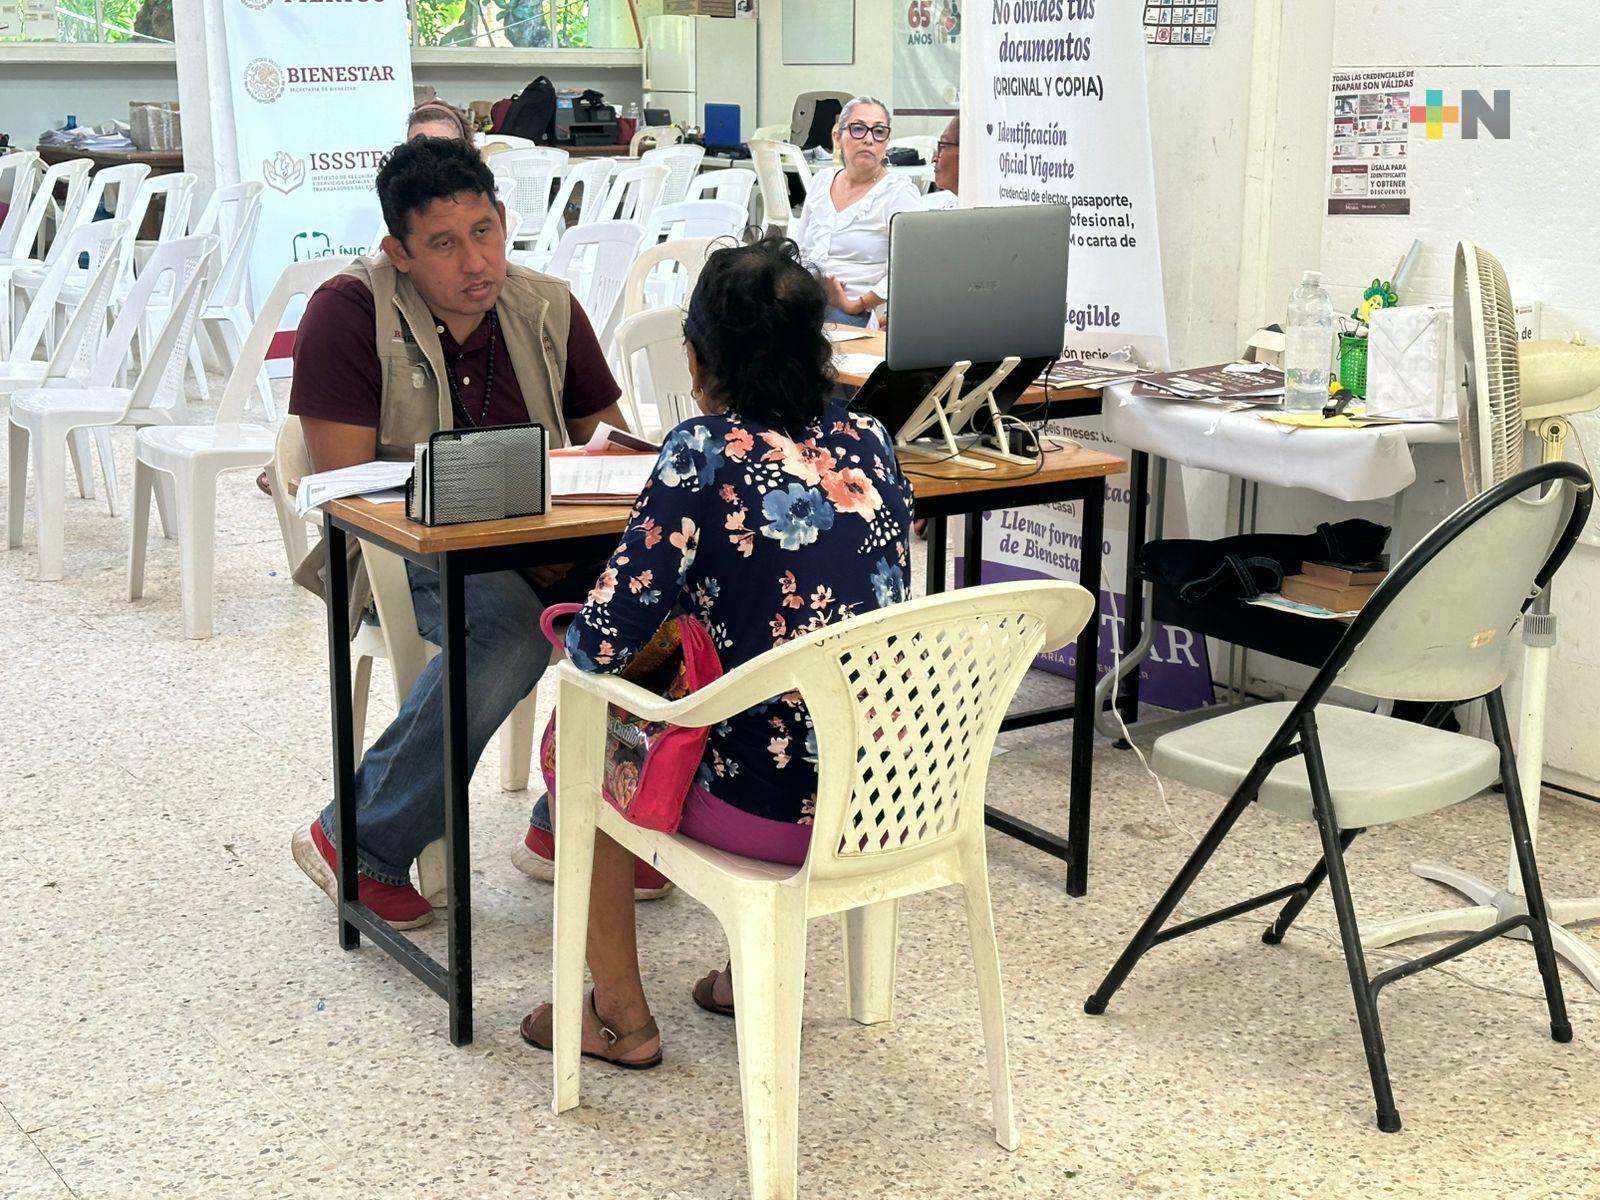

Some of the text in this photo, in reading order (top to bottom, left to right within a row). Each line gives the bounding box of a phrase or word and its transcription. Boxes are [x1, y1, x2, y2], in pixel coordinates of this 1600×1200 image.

[908, 0, 932, 28] 65
[992, 0, 1095, 25] No olvides tus
[908, 31, 933, 45] AÑOS
[999, 32, 1091, 63] documentos
[287, 66, 395, 83] BIENESTAR
[1332, 78, 1414, 92] INAPAM SON VÁLIDAS
[1363, 71, 1405, 80] CREDENCIALES
[994, 75, 1103, 101] (ORIGINAL Y COPIA)
[998, 121, 1068, 150] Identificación
[999, 152, 1074, 184] Oficial Vigente
[1371, 163, 1390, 171] ÚSALA
[999, 185, 1030, 202] (credencial
[1031, 189, 1041, 203] de
[1072, 195, 1133, 209] pasaporte,
[1071, 213, 1135, 229] ofesional,
[1078, 236, 1084, 247] o
[1086, 235, 1117, 248] carta
[1120, 234, 1137, 248] de
[1066, 304, 1121, 332] egible
[1522, 327, 1532, 340] de
[1081, 348, 1112, 360] recie
[1045, 421, 1061, 435] seis
[1062, 427, 1099, 442] meses:
[1000, 510, 1111, 556] Llenar formo
[1000, 533, 1082, 573] de Bienesta
